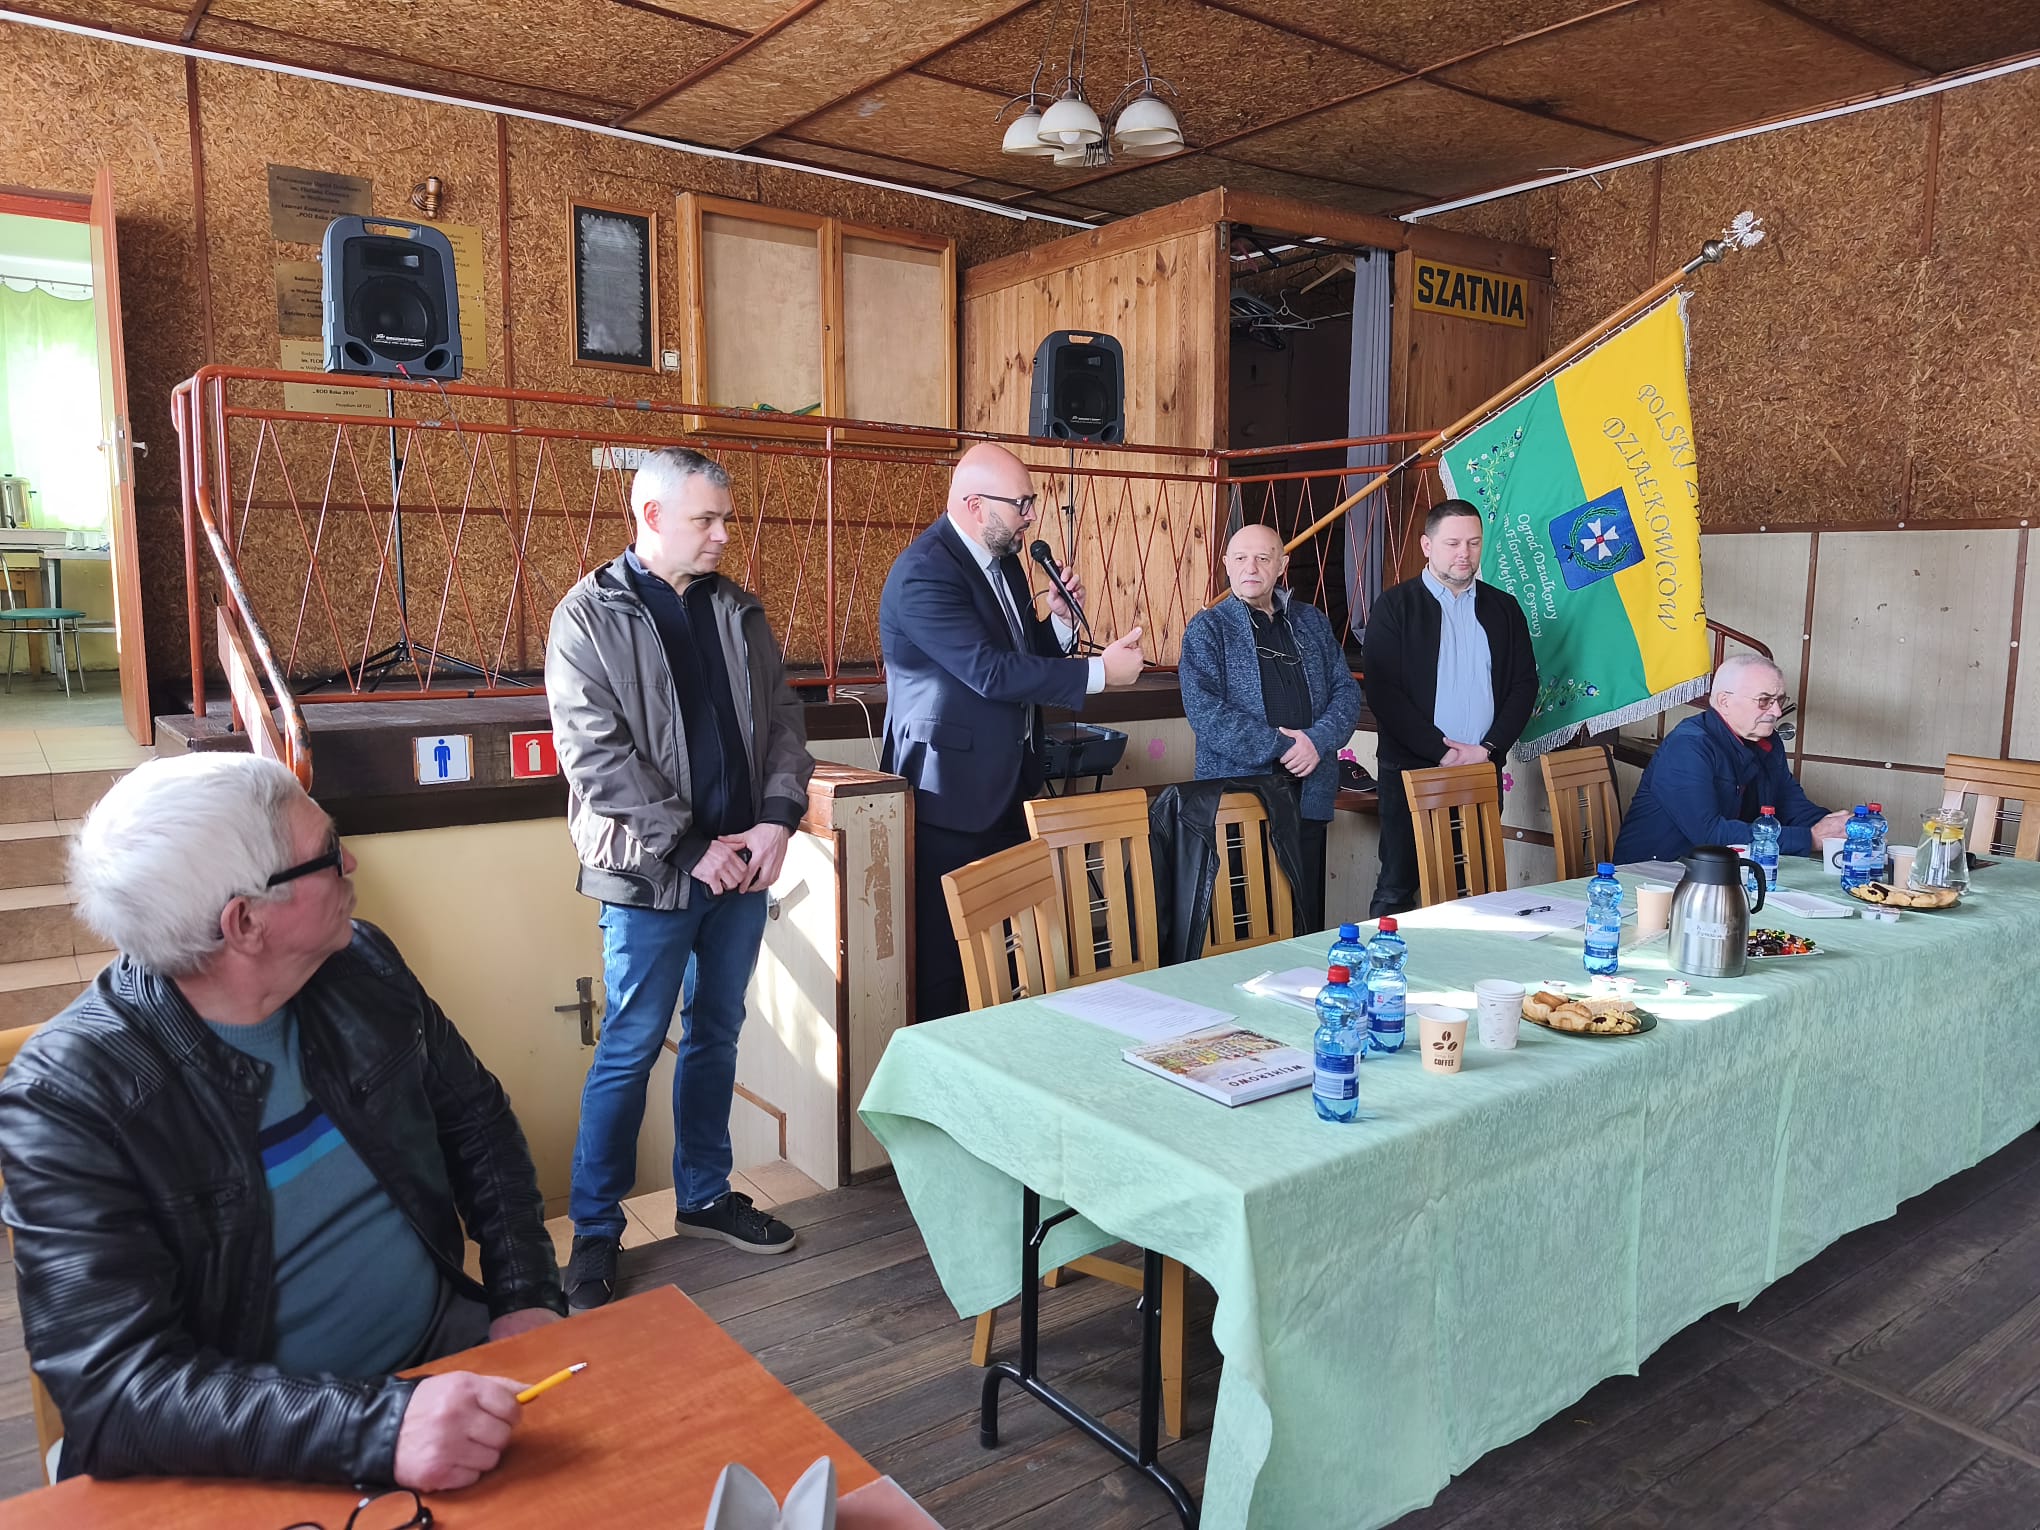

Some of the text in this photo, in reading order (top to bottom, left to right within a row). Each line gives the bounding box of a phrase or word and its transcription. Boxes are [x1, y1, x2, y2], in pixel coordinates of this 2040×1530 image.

[1418, 265, 1525, 320] SZATNIA
[1638, 384, 1697, 469] POLSKI
[1603, 417, 1680, 631] DZIAŁKOWCÓW
[1498, 553, 1517, 597] Wejher
[1518, 513, 1557, 620] Ogród Działkowy
[1523, 583, 1543, 638] Ceynowy
[1228, 1064, 1306, 1087] WEJHEROWO
[1434, 1058, 1454, 1067] COFFEE
